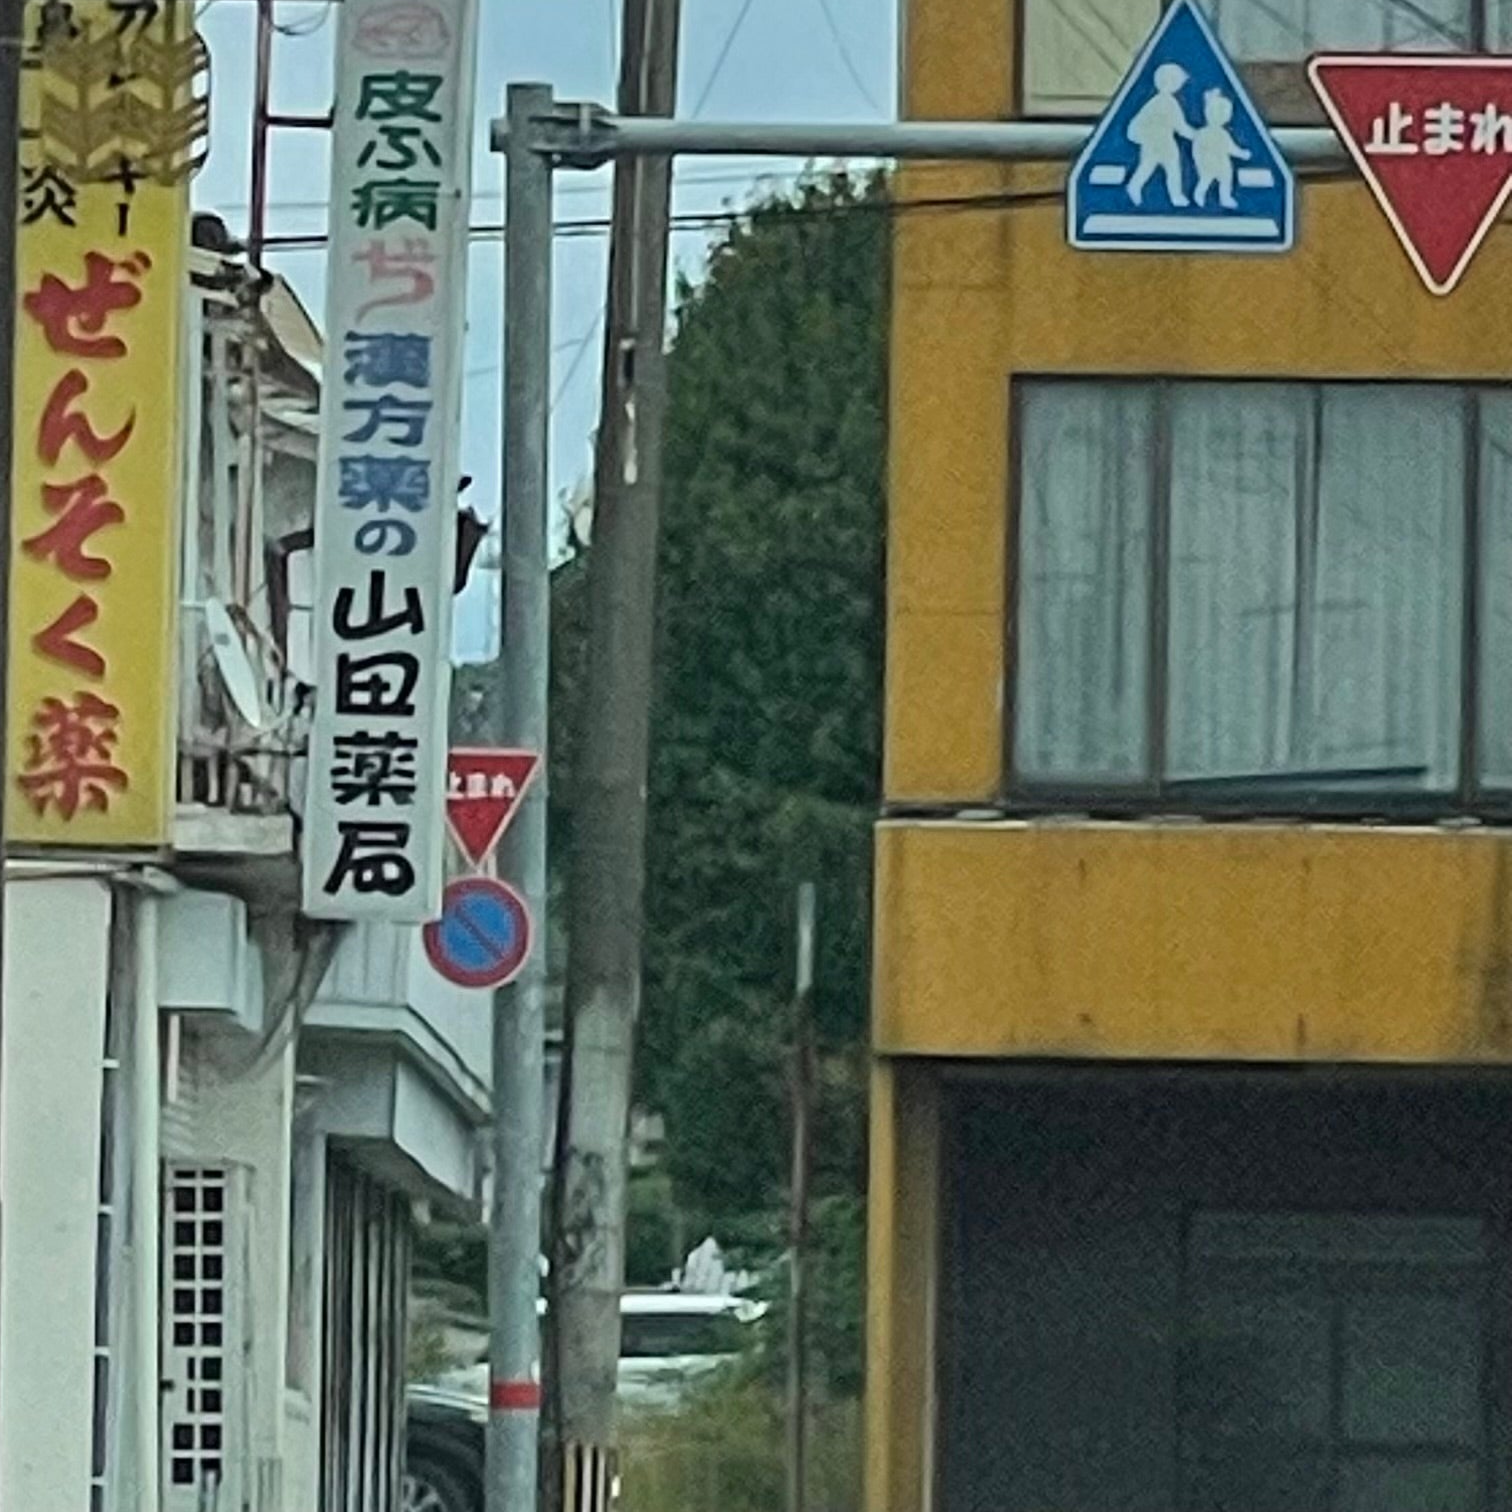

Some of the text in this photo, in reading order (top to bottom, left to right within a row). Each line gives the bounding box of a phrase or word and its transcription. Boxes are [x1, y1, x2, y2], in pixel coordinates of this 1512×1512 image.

[1364, 101, 1512, 155] 止まれ
[18, 250, 152, 822] ぜんそく薬
